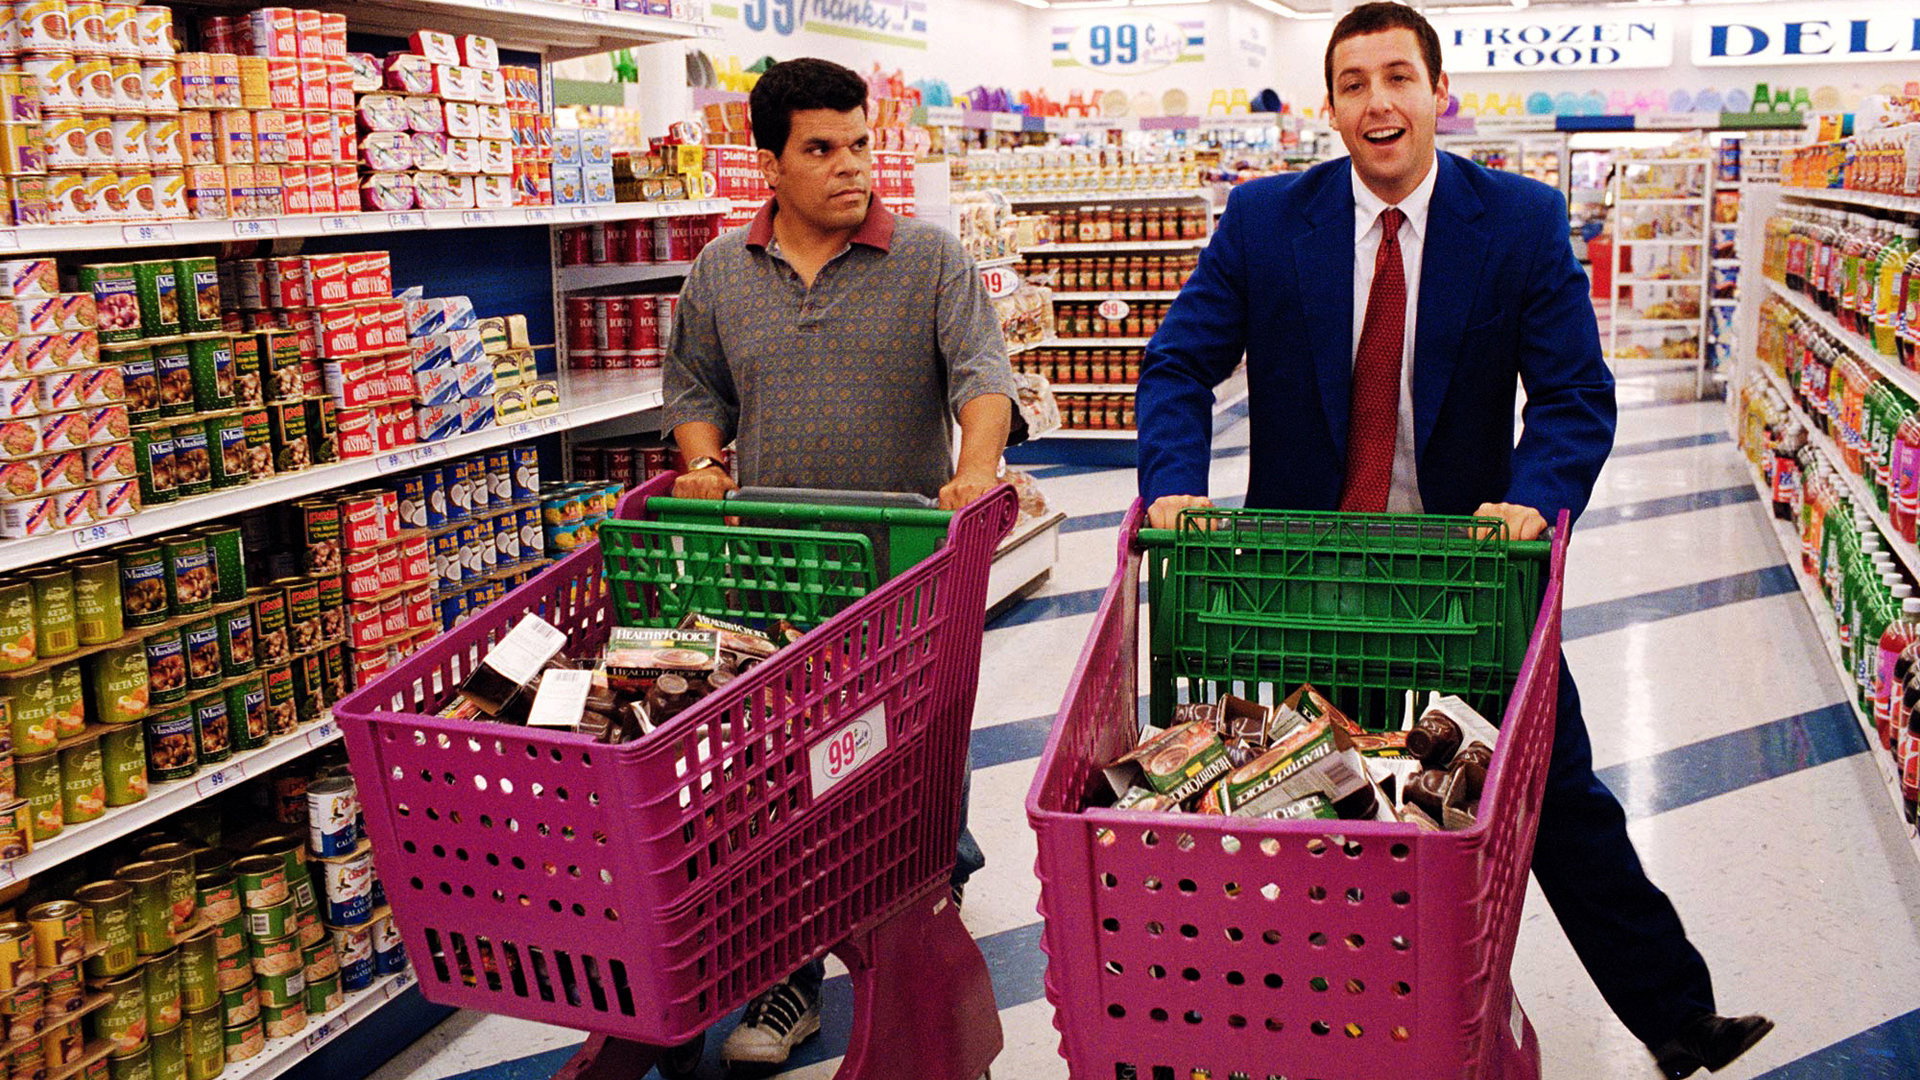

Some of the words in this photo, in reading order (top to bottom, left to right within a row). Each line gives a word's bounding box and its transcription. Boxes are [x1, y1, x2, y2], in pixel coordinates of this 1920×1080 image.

[1453, 22, 1656, 47] FROZEN
[1486, 46, 1621, 67] FOOD
[616, 629, 664, 641] HEALTHY
[667, 631, 711, 642] CHOICE
